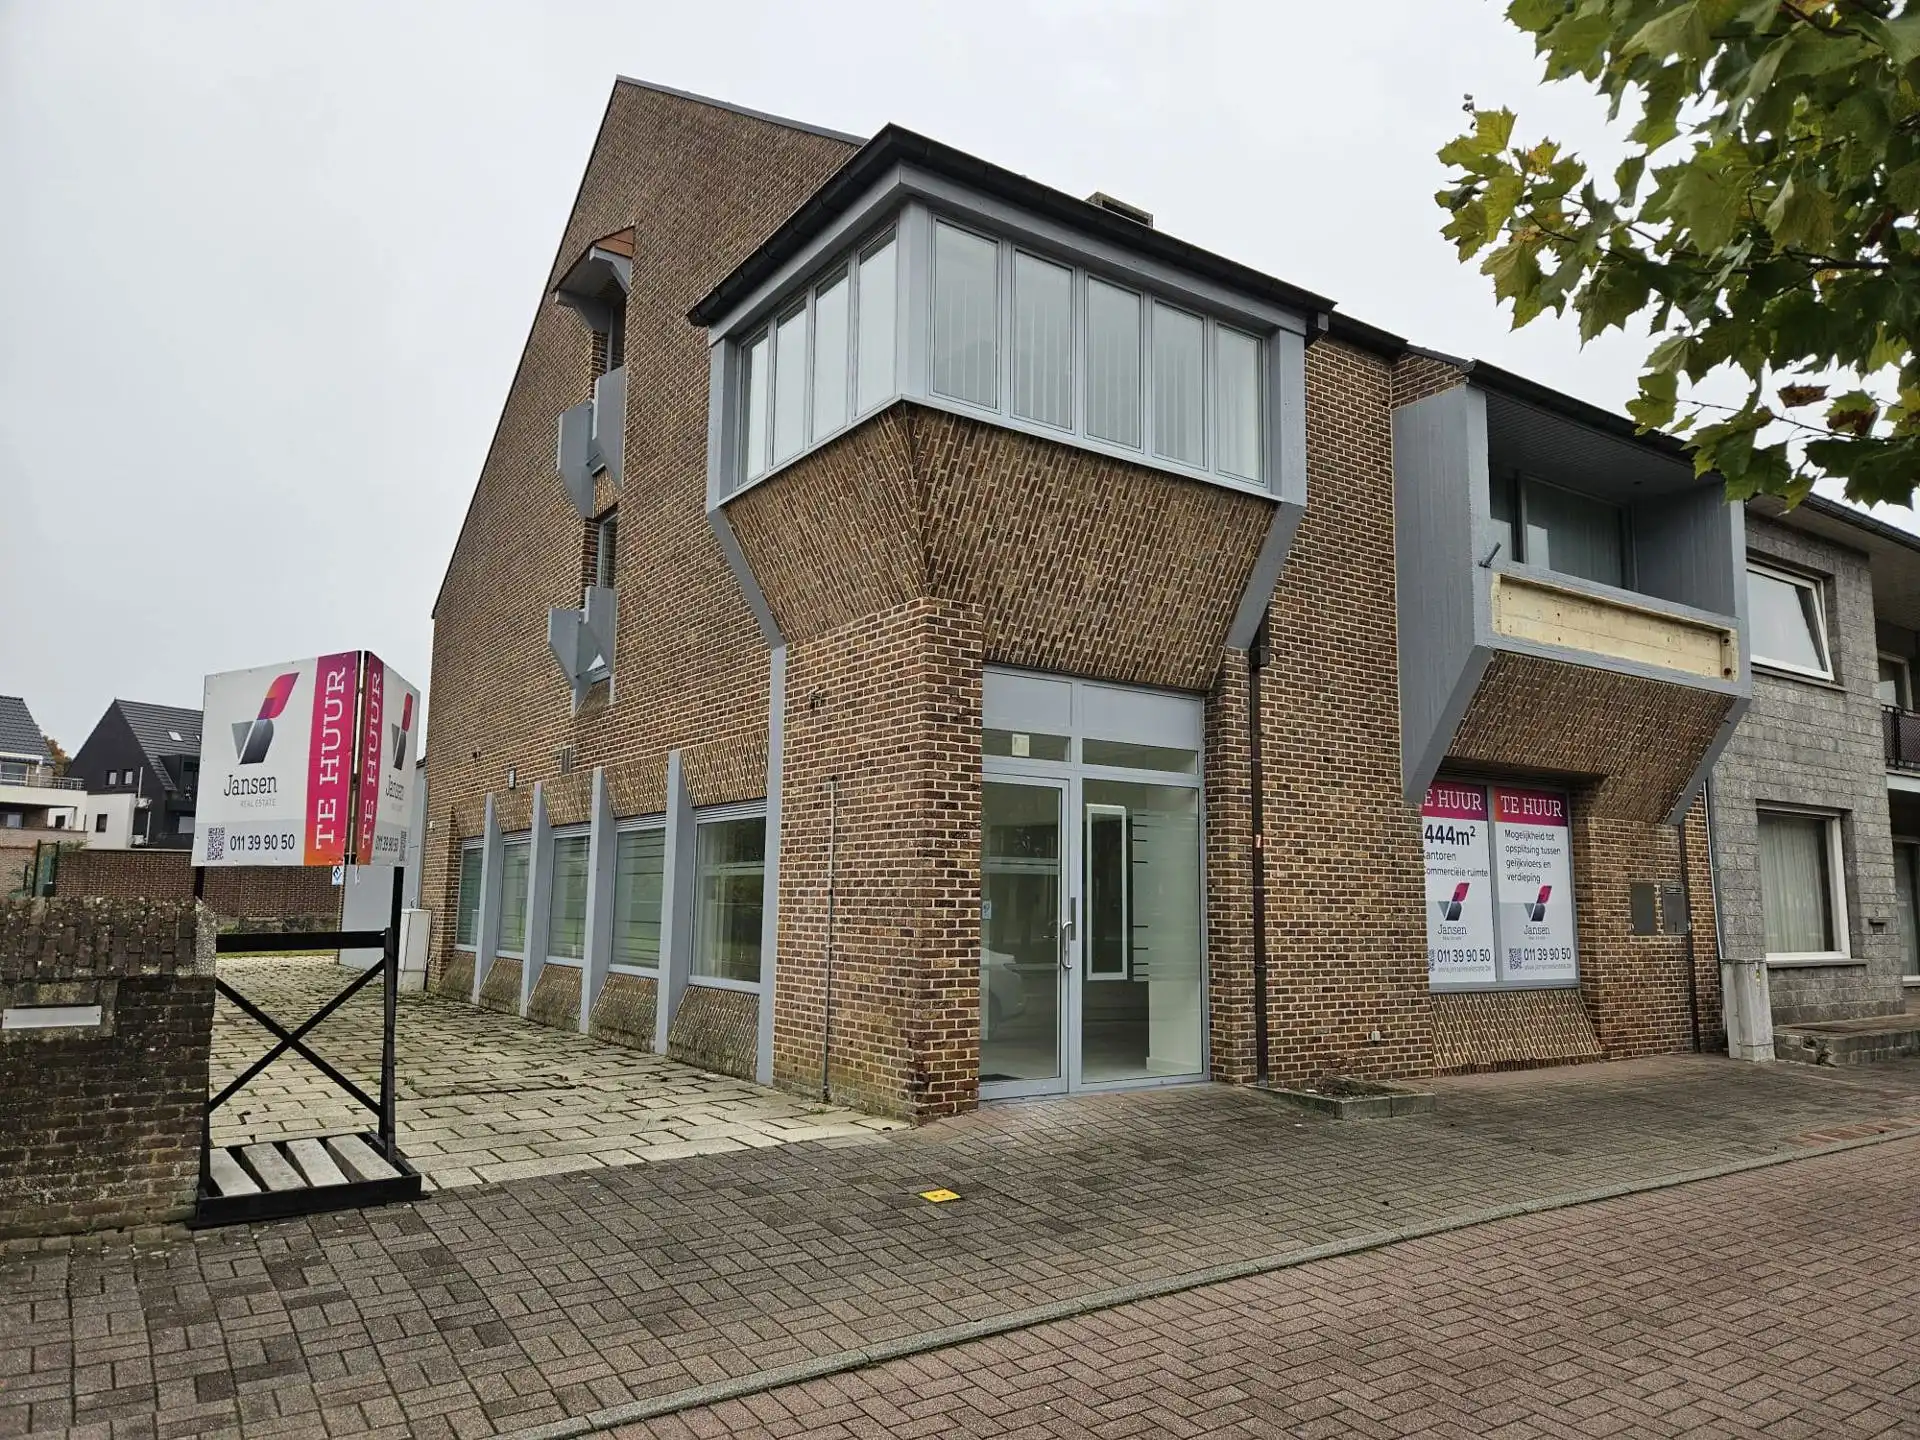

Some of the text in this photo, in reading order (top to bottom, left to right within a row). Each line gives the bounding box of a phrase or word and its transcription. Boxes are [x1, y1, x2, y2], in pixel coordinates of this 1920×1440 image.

[315, 666, 346, 850] TE HUUR
[362, 672, 381, 849] TE HUUR
[223, 774, 278, 797] Jansen
[240, 798, 277, 808] REAL ESTATE
[1423, 788, 1482, 811] E HUUR
[1501, 795, 1562, 817] TE HUUR
[1504, 829, 1555, 841] Mogelijkheid tot
[229, 833, 295, 851] 011 39 90 50
[1505, 844, 1561, 856] opsplitsing tussen
[1506, 859, 1552, 869] gelijkvloers en
[1467, 868, 1489, 877] ruimte
[1507, 873, 1541, 884] verdieping
[1437, 924, 1467, 935] Jansen
[1523, 925, 1551, 935] Jansen
[1437, 948, 1491, 963] 011 39 90 50
[1523, 947, 1572, 961] 011 39 90 50
